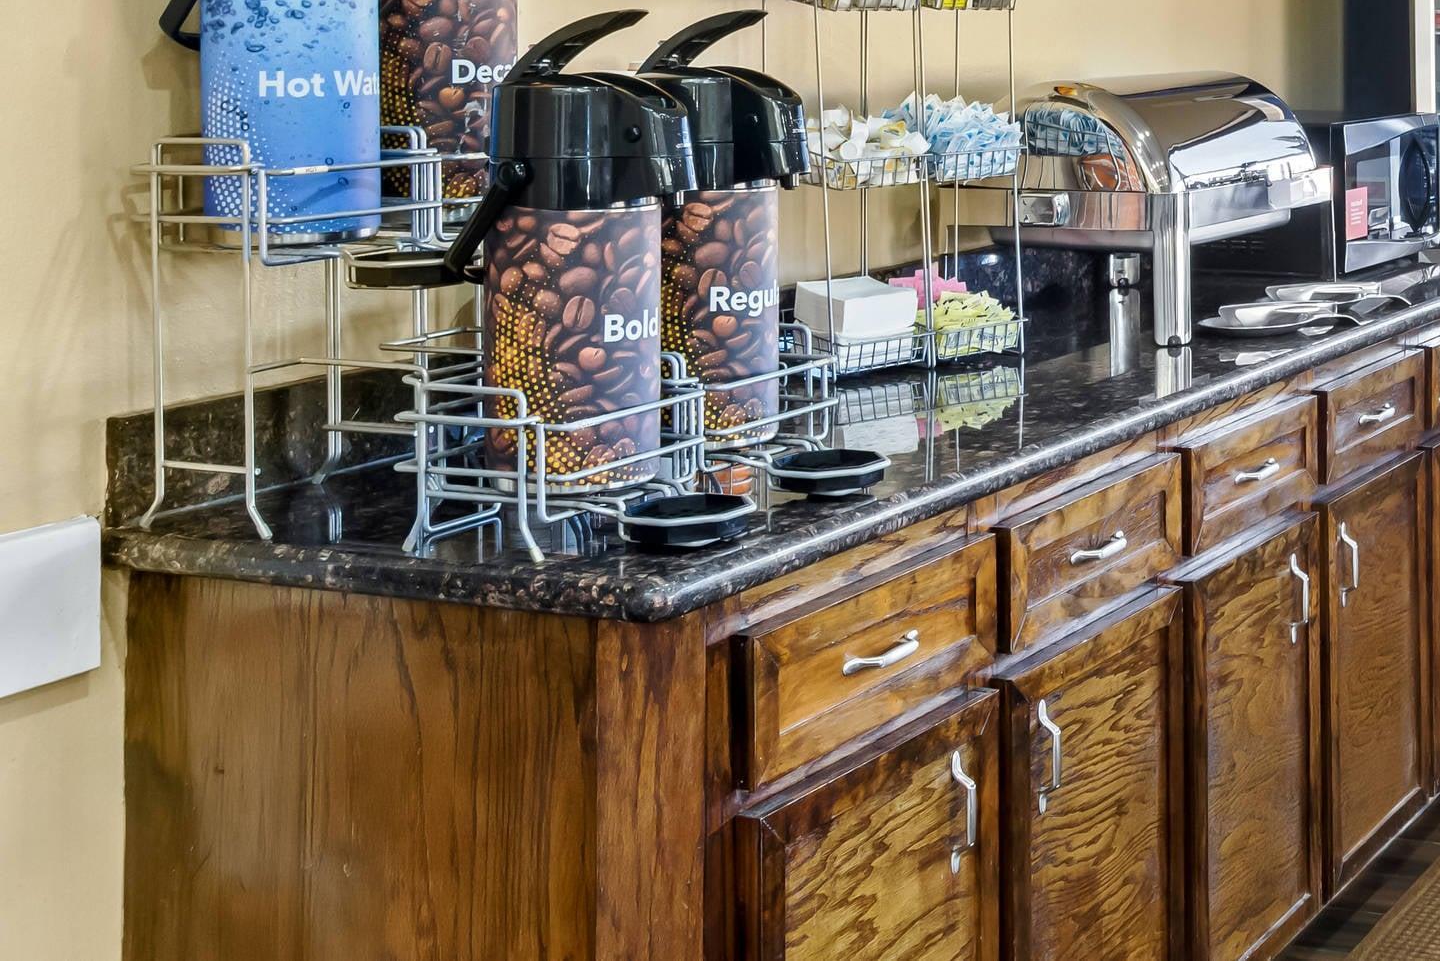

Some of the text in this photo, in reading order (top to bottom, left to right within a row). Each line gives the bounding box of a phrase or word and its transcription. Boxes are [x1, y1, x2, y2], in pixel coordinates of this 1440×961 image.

[258, 69, 325, 99] Hot
[451, 56, 518, 85] Deca
[603, 306, 659, 343] Bold
